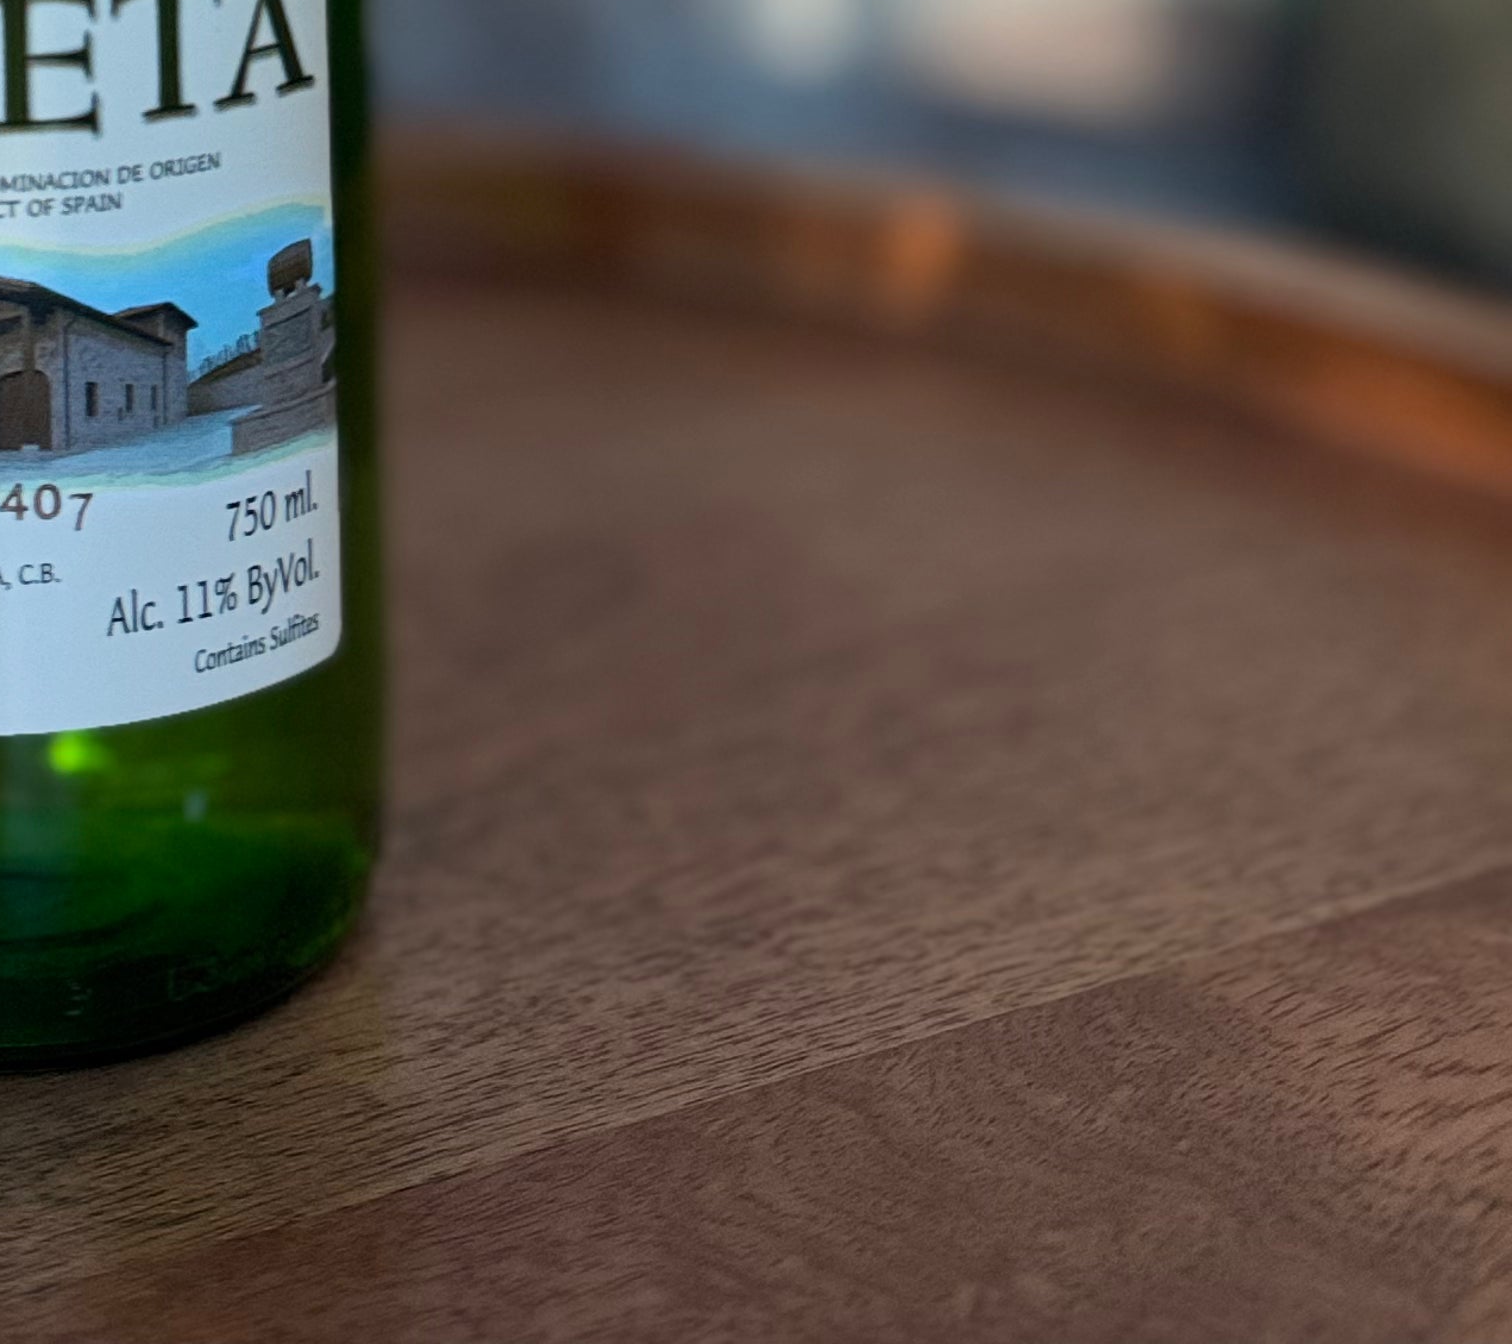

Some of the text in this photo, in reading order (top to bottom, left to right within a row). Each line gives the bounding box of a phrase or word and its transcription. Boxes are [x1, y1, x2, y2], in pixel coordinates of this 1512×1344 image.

[117, 163, 143, 184] DE
[149, 151, 222, 180] ORIGEN
[26, 197, 55, 218] OF
[61, 192, 124, 215] SPAIN
[226, 469, 318, 541] 750 ml.
[18, 563, 62, 586] C.B.
[106, 588, 163, 636] Alc.
[177, 573, 238, 623] 11%
[194, 634, 267, 673] Contains
